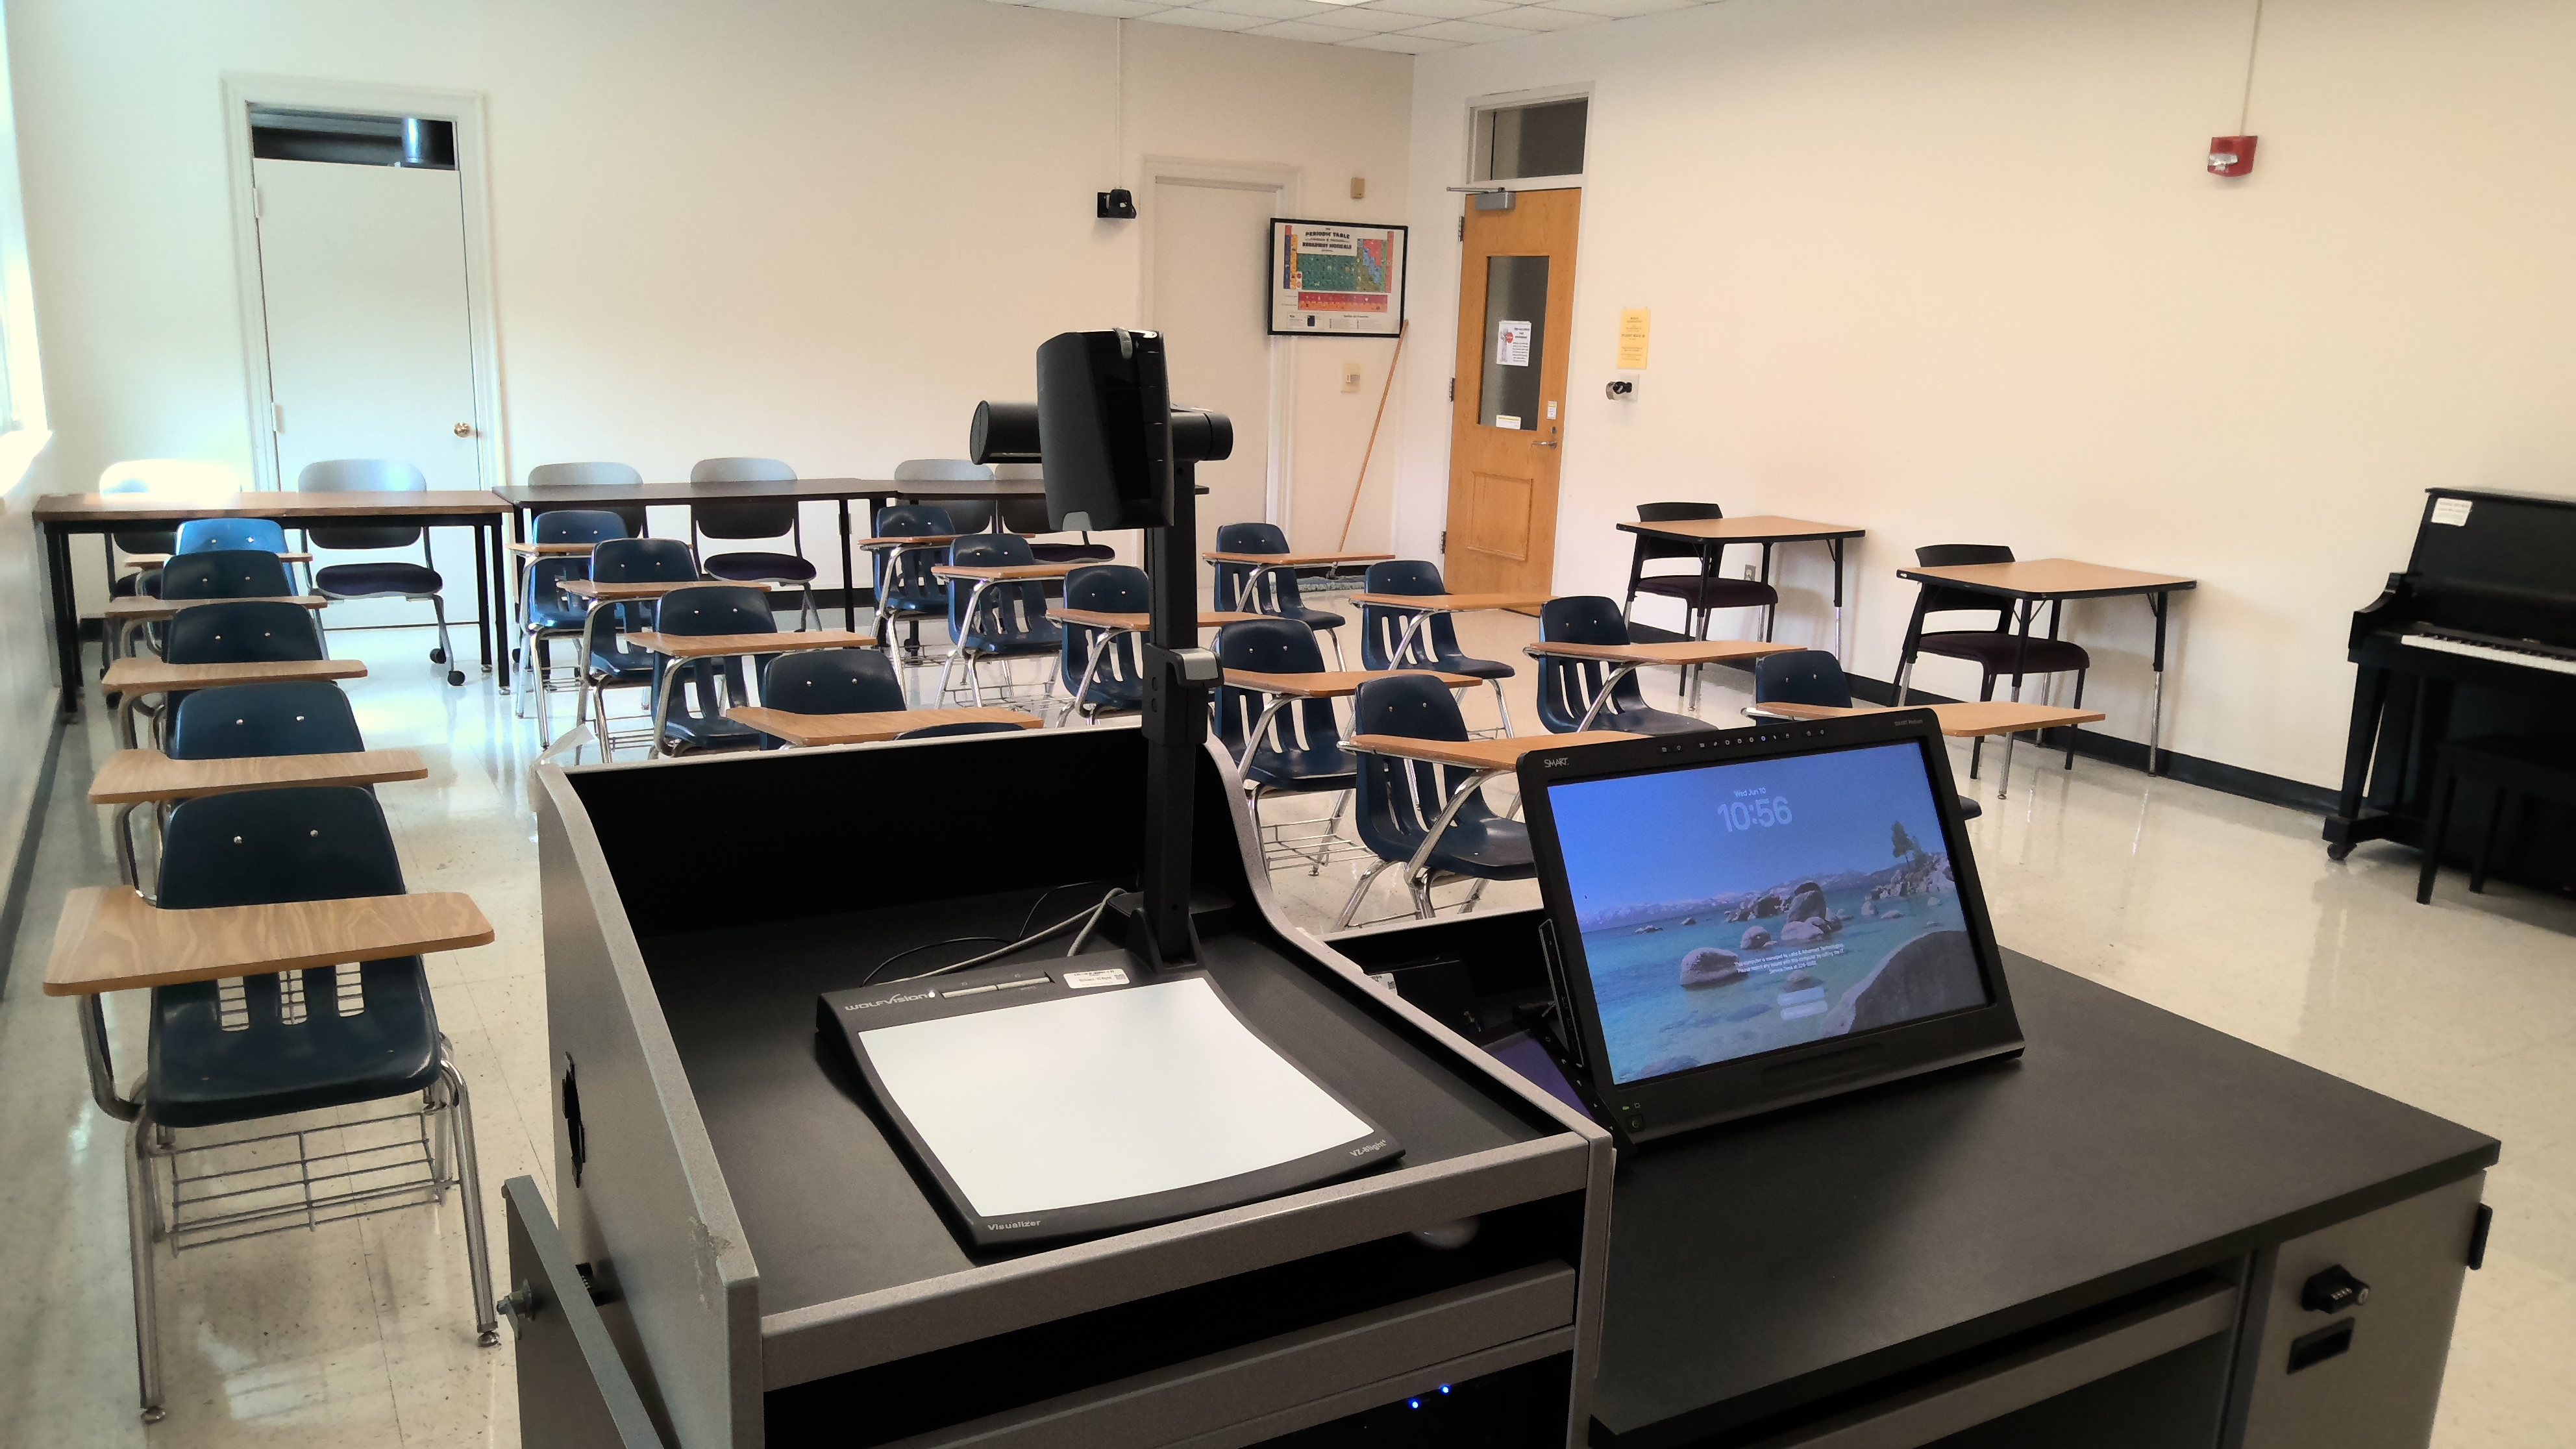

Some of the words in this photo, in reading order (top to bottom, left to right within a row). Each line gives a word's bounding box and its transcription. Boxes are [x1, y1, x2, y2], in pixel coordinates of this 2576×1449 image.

[1544, 757, 1568, 768] SMART
[1734, 789, 1748, 798] Wed
[1717, 796, 1792, 832] 10:56
[987, 1220, 1041, 1231] Visualizer
